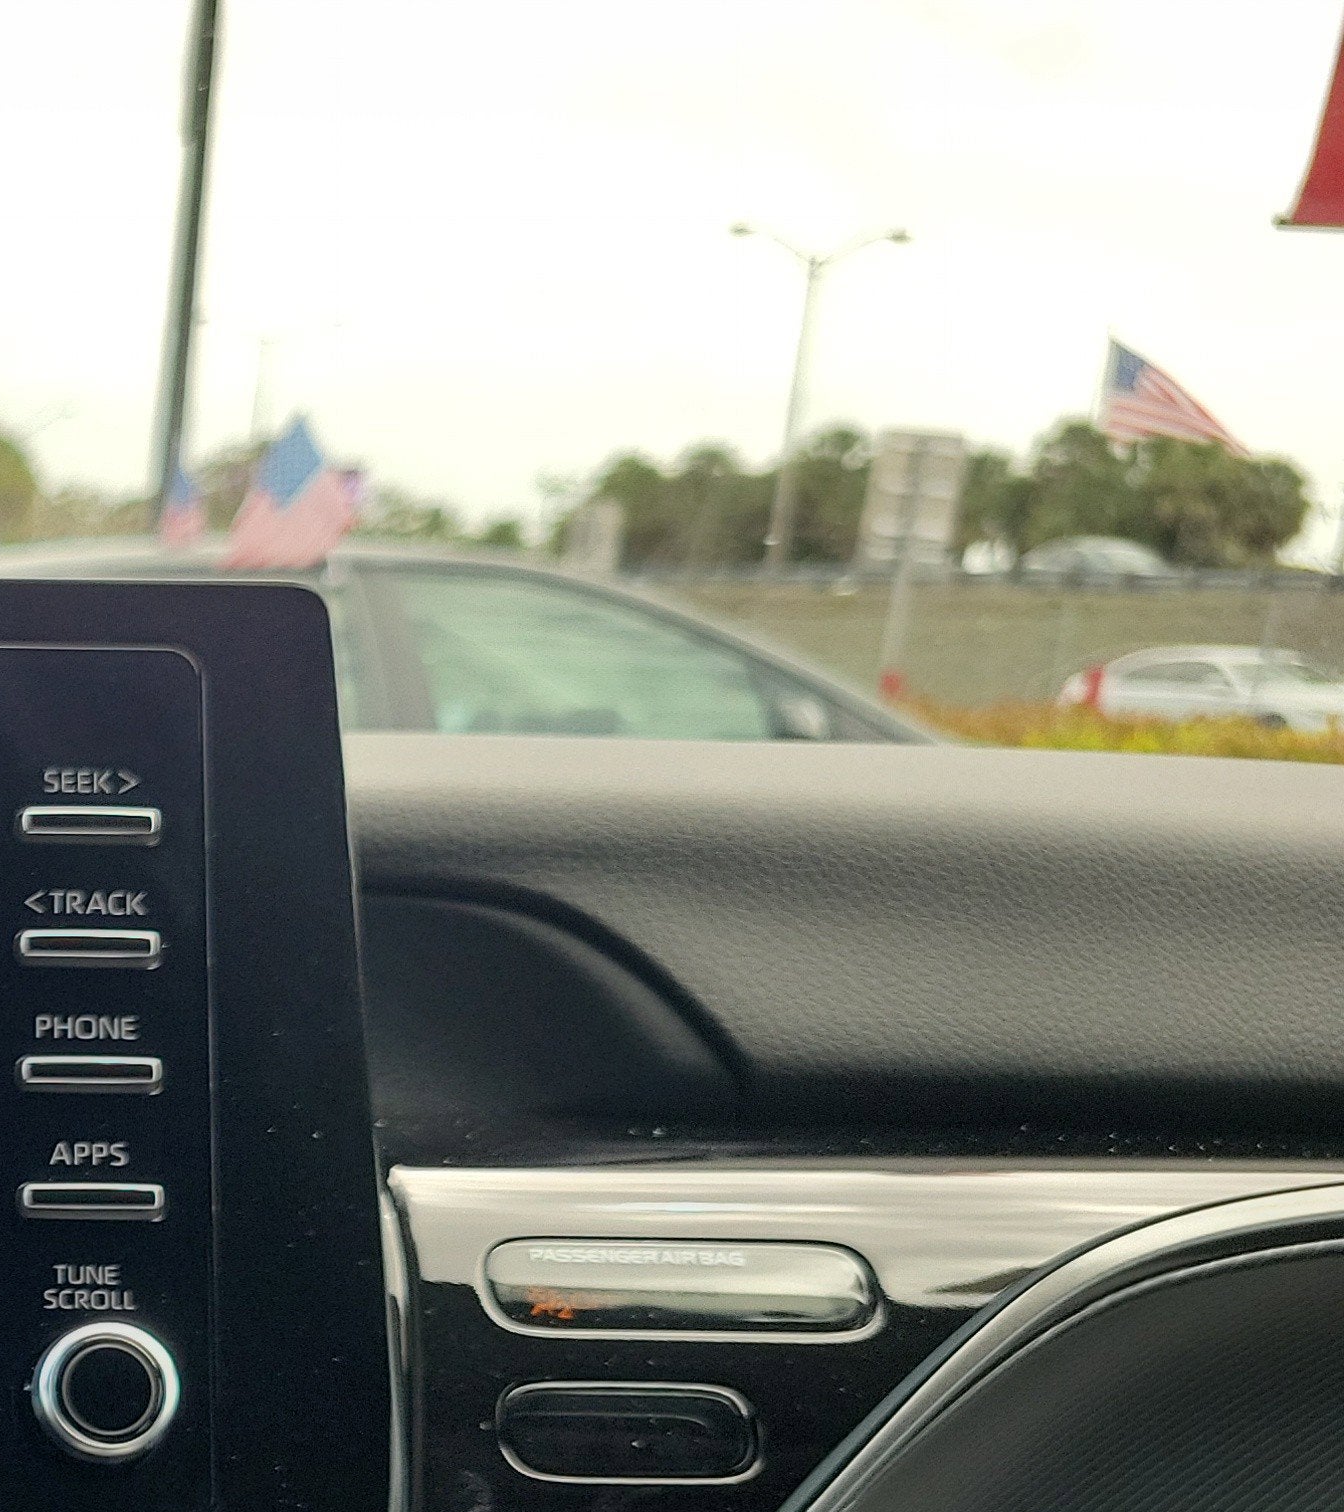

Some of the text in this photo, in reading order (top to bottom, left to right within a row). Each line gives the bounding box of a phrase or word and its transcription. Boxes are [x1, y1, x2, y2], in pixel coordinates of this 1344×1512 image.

[35, 1015, 140, 1041] PHONE
[50, 1142, 129, 1167] APPS
[529, 1248, 658, 1265] PASSENGER
[52, 1264, 121, 1286] TUNE
[43, 1289, 136, 1311] SCROLL
